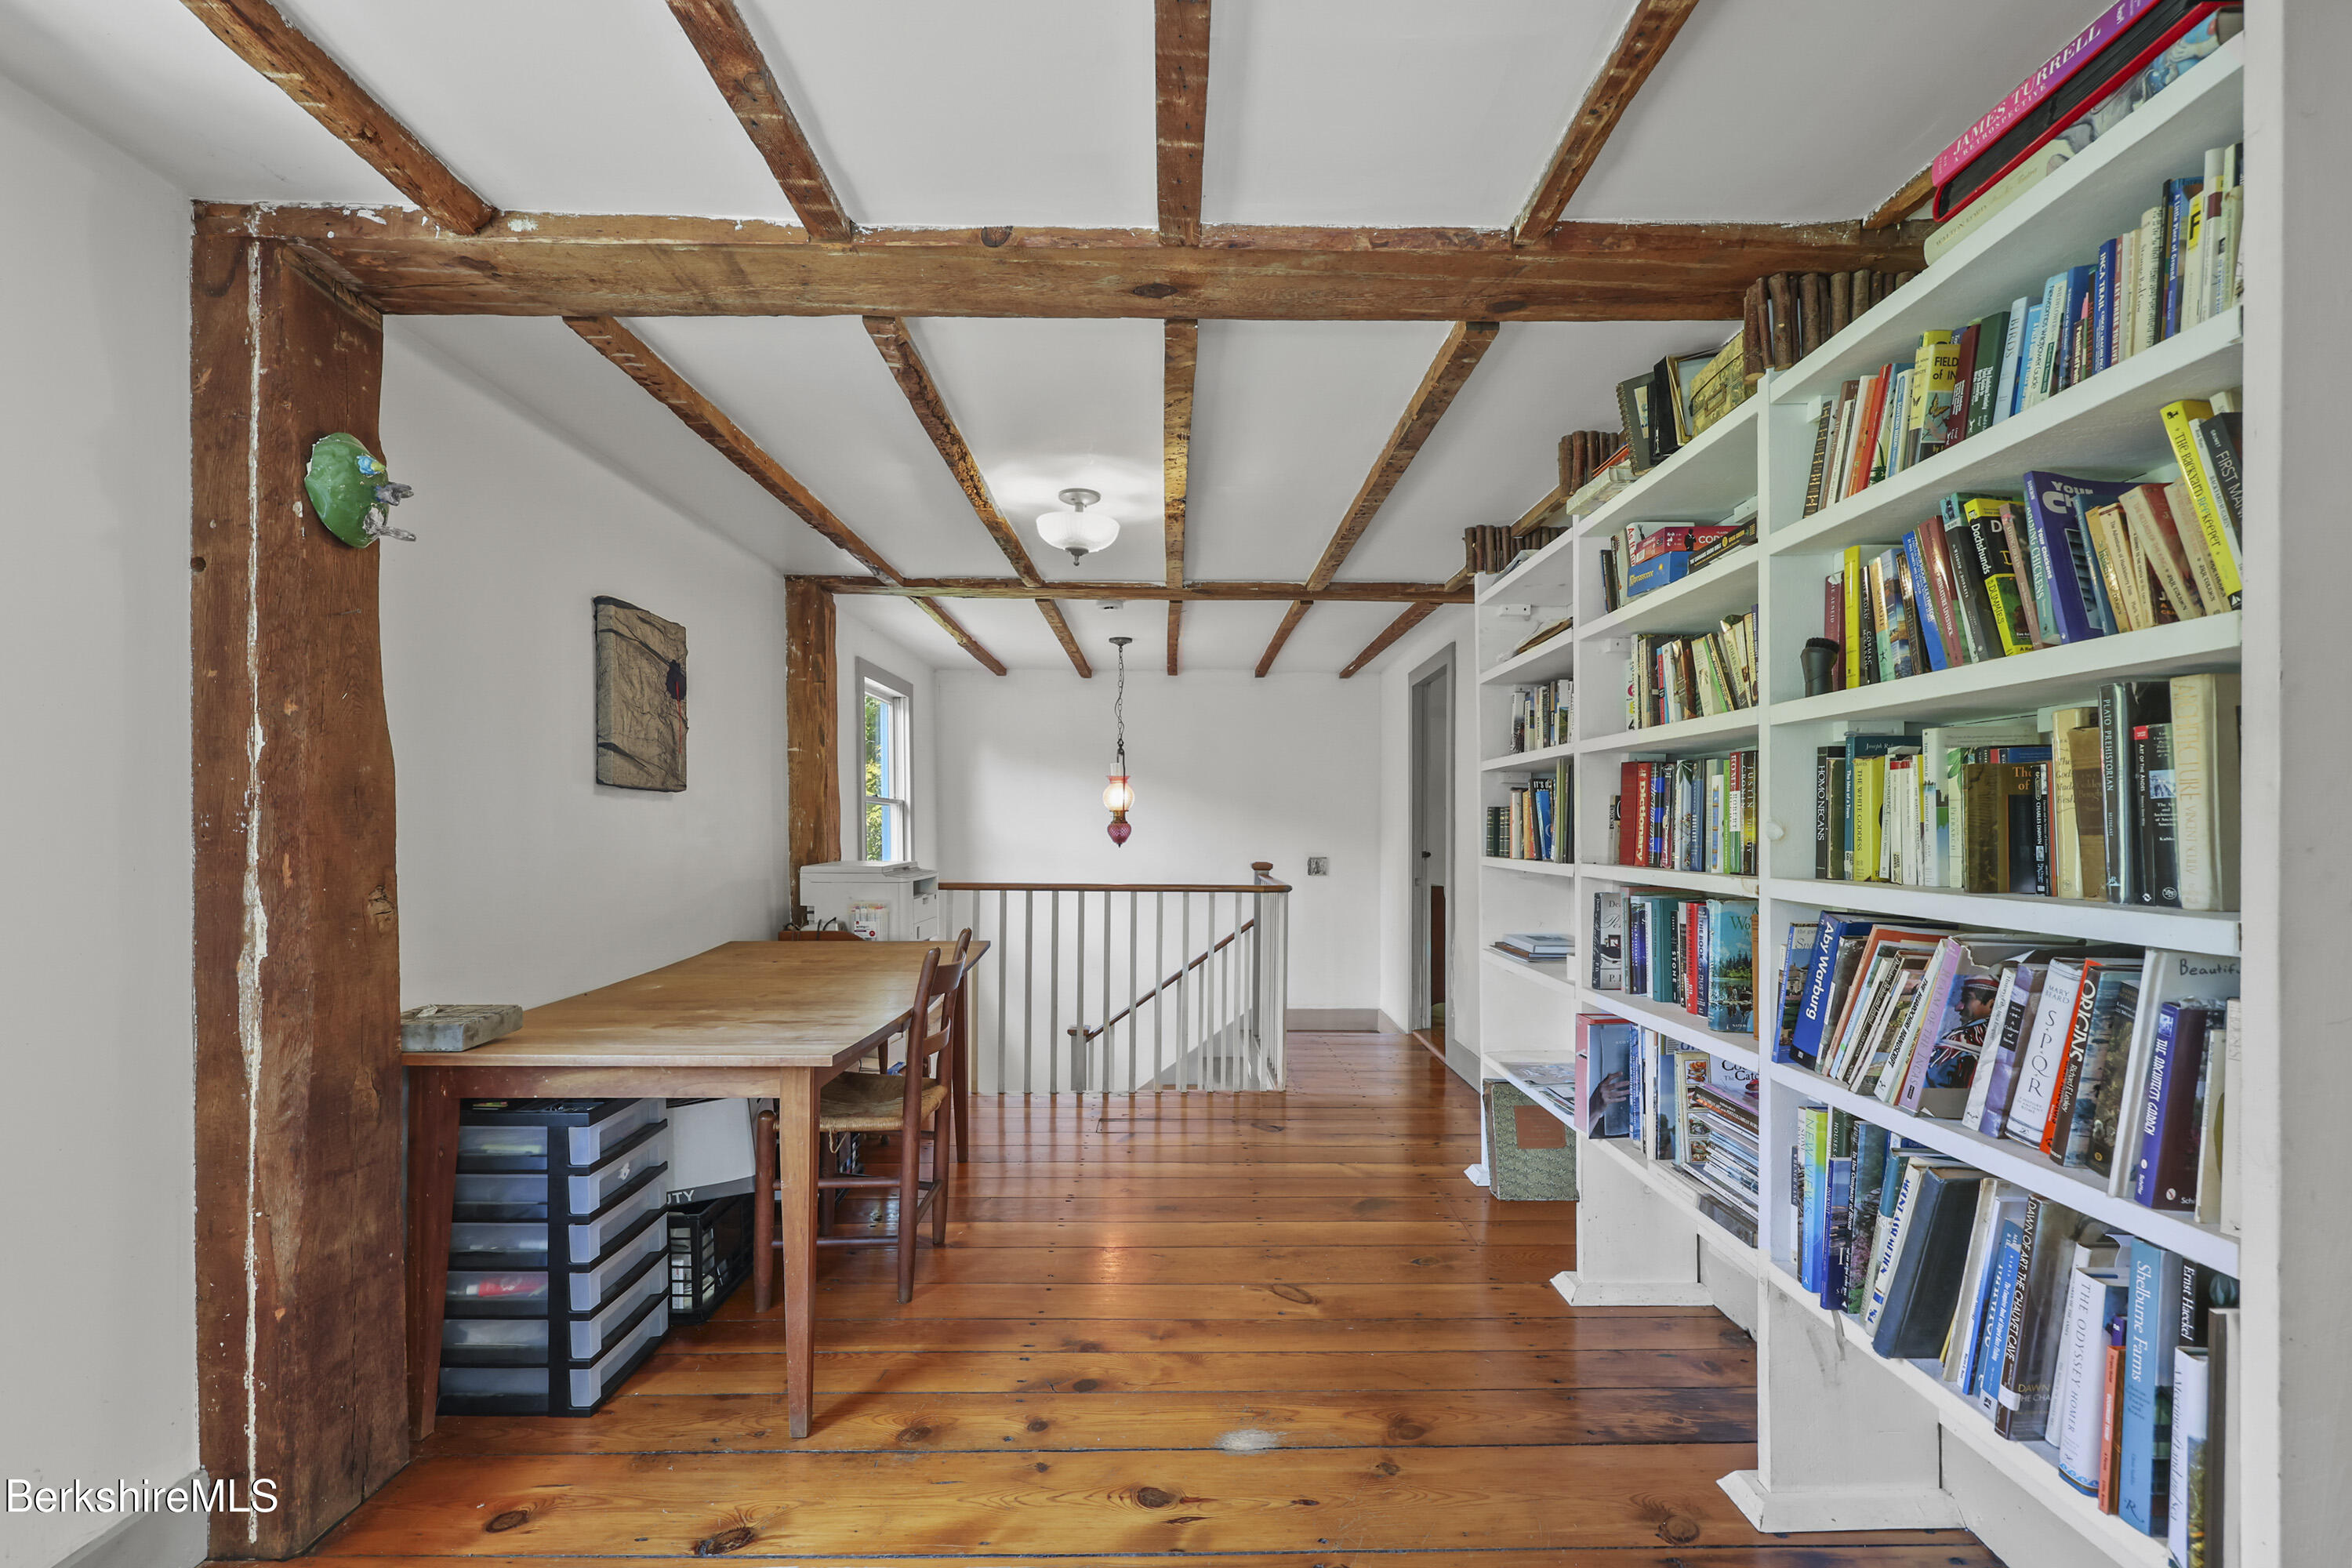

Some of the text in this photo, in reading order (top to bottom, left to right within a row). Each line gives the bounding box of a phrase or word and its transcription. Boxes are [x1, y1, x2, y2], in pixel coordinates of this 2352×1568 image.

[1953, 24, 2101, 155] JAMES TURRELL
[1970, 522, 1992, 575] Dachshunds
[2104, 730, 2114, 792] PREHISTORIAN
[1635, 780, 1646, 861] Dictionary
[1730, 916, 1751, 931] Wo
[1806, 921, 1835, 1021] Aby Warburg
[2048, 985, 2070, 996] MARY
[2179, 958, 2241, 976] Beautif
[2070, 979, 2096, 1062] ORIGINS
[2023, 1200, 2037, 1236] DAWN
[2180, 1196, 2195, 1205] Schi
[2020, 1235, 2031, 1250] OF
[2014, 1271, 2027, 1290] THE
[2132, 1260, 2153, 1334] Shelburne
[2179, 1265, 2196, 1341] Ernst Haeckel
[2008, 1289, 2024, 1336] CHAUVET
[2004, 1334, 2018, 1361] CAVE
[2066, 1283, 2091, 1432] THE ODYSSEY HOMER
[2129, 1334, 2148, 1382] Farms
